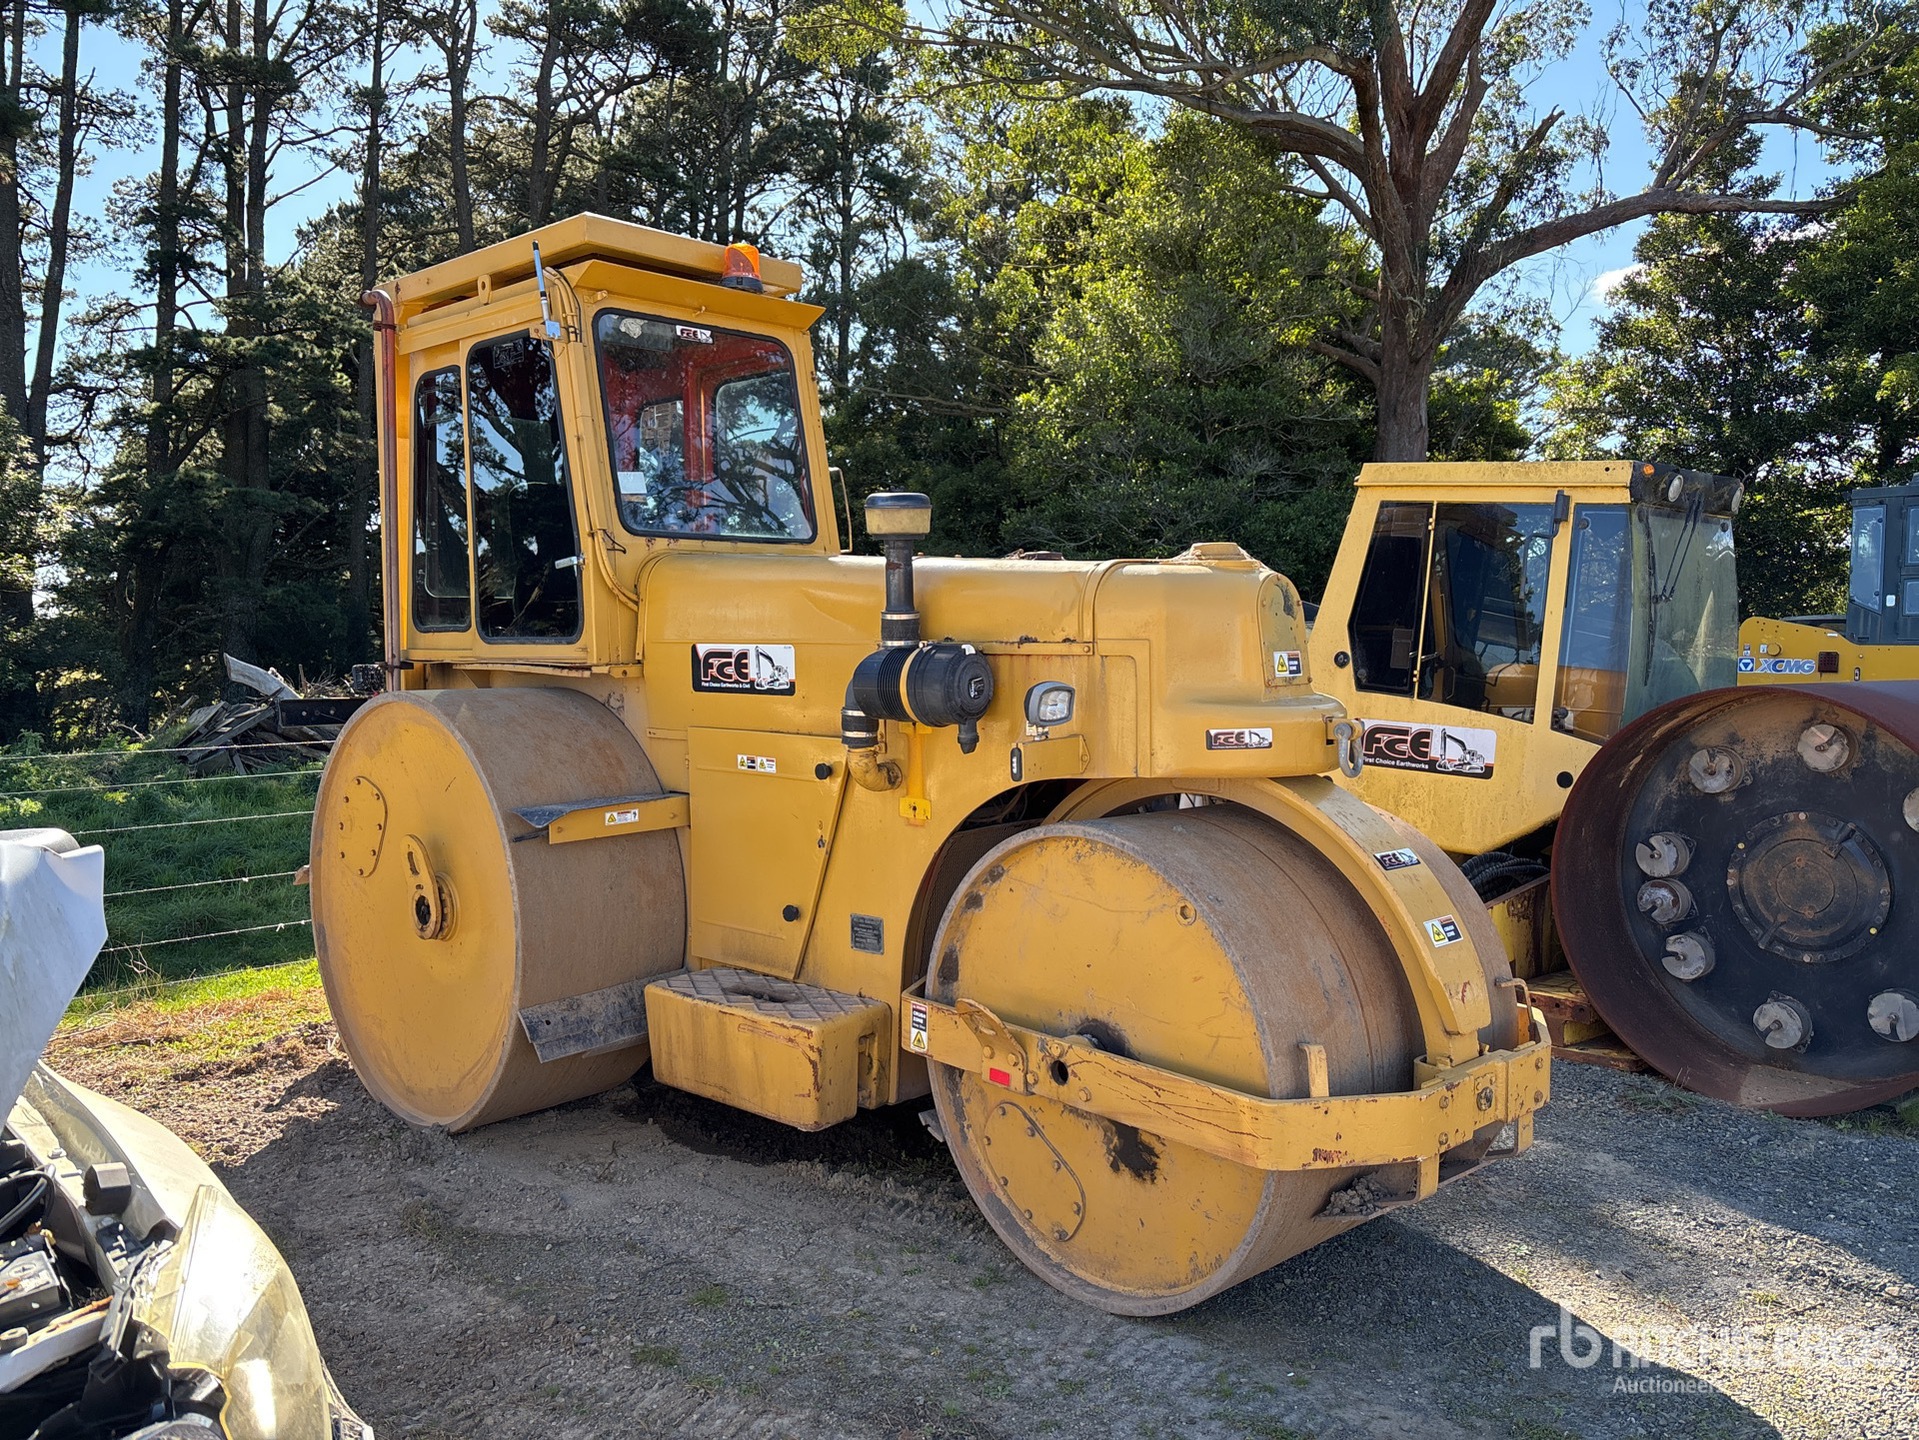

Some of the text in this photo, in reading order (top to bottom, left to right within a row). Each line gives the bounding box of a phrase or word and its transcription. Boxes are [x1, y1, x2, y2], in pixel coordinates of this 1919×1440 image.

[701, 648, 750, 682] FCE
[1757, 658, 1815, 674] XCMG
[1212, 731, 1245, 745] FCE
[1363, 724, 1433, 760] FCE
[1375, 757, 1395, 766] Choice
[1396, 759, 1429, 769] Earthworks
